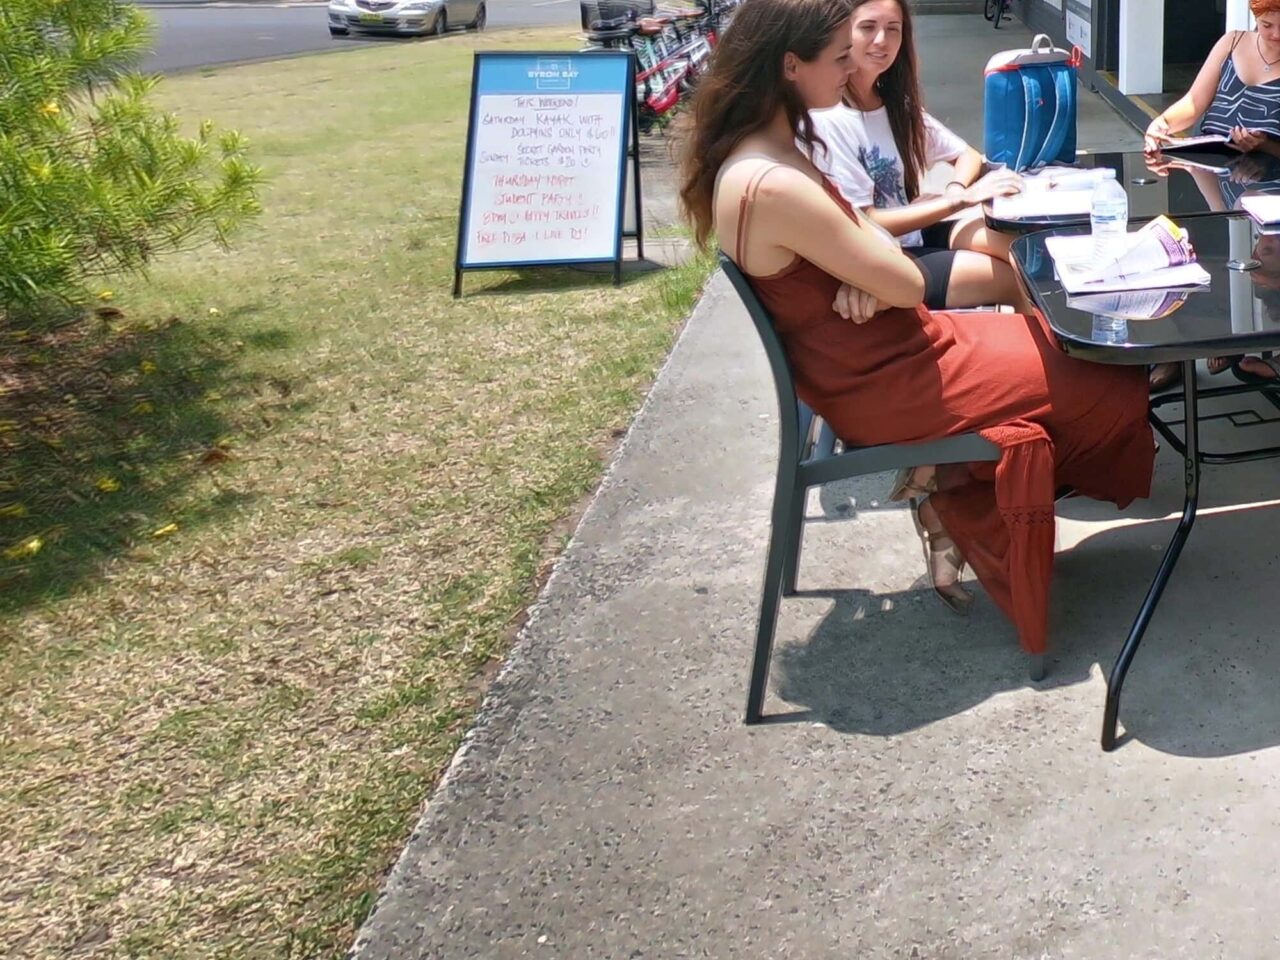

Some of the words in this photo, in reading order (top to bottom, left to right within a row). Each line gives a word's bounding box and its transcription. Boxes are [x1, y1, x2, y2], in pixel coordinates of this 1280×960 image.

[536, 113, 571, 125] KAYAK
[579, 114, 604, 126] WITH
[510, 126, 553, 139] DOLPHINS
[558, 127, 581, 141] ONLY
